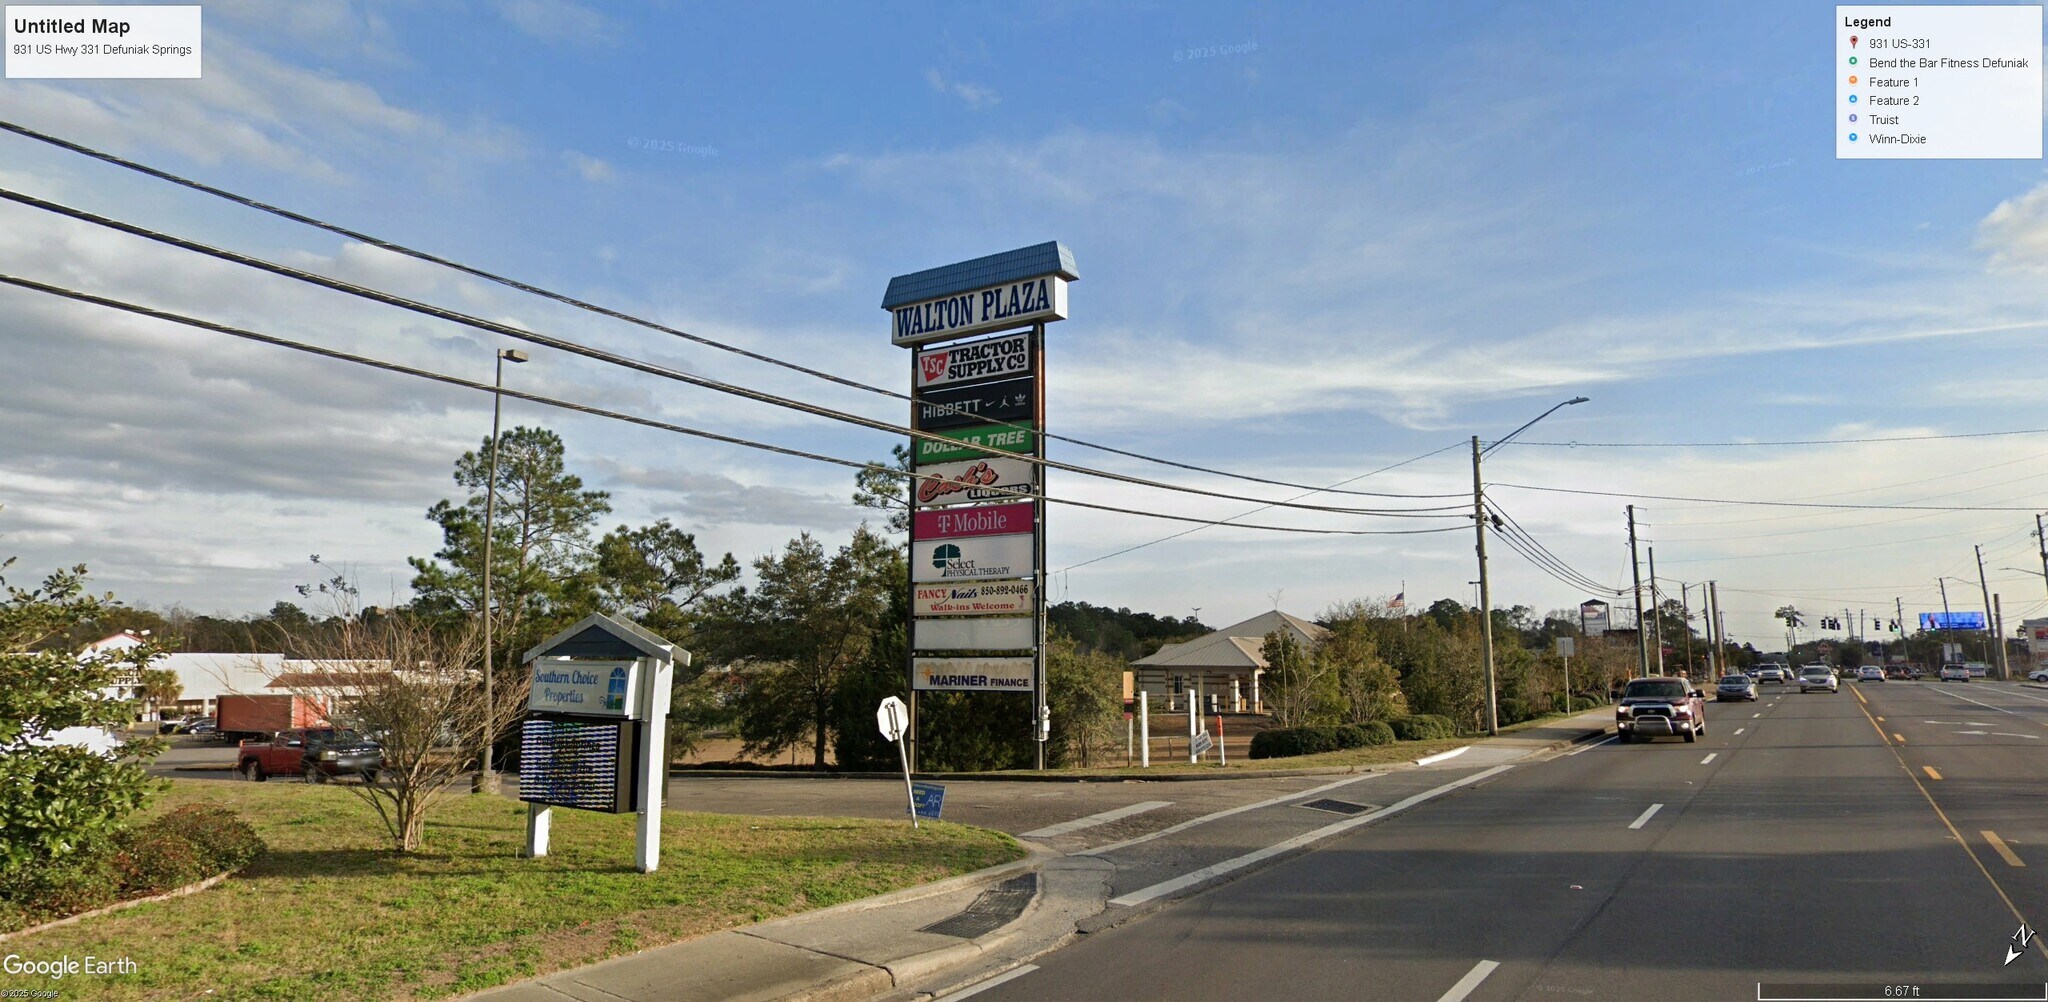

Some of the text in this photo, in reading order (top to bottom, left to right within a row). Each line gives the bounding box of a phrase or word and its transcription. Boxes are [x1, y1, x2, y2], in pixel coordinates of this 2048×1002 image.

[896, 279, 1050, 337] WALTON PLAZA
[949, 338, 1025, 364] TRACTOR
[922, 356, 943, 375] TSC
[948, 357, 1006, 379] SUPPLY
[922, 399, 982, 419] HIBBETT
[987, 430, 1026, 447] TREE
[917, 462, 999, 502] Cash's
[953, 511, 1007, 532] Mobile
[946, 558, 975, 570] Select
[946, 566, 1010, 577] PHYSICAL THERAPY
[917, 584, 1029, 601] FANCY Nails 850-892-0466
[930, 602, 1015, 612] Walk-ins Welcome
[535, 669, 599, 685] Southern Choice
[929, 675, 1029, 687] MARINER FINANCE
[544, 687, 584, 705] Properties
